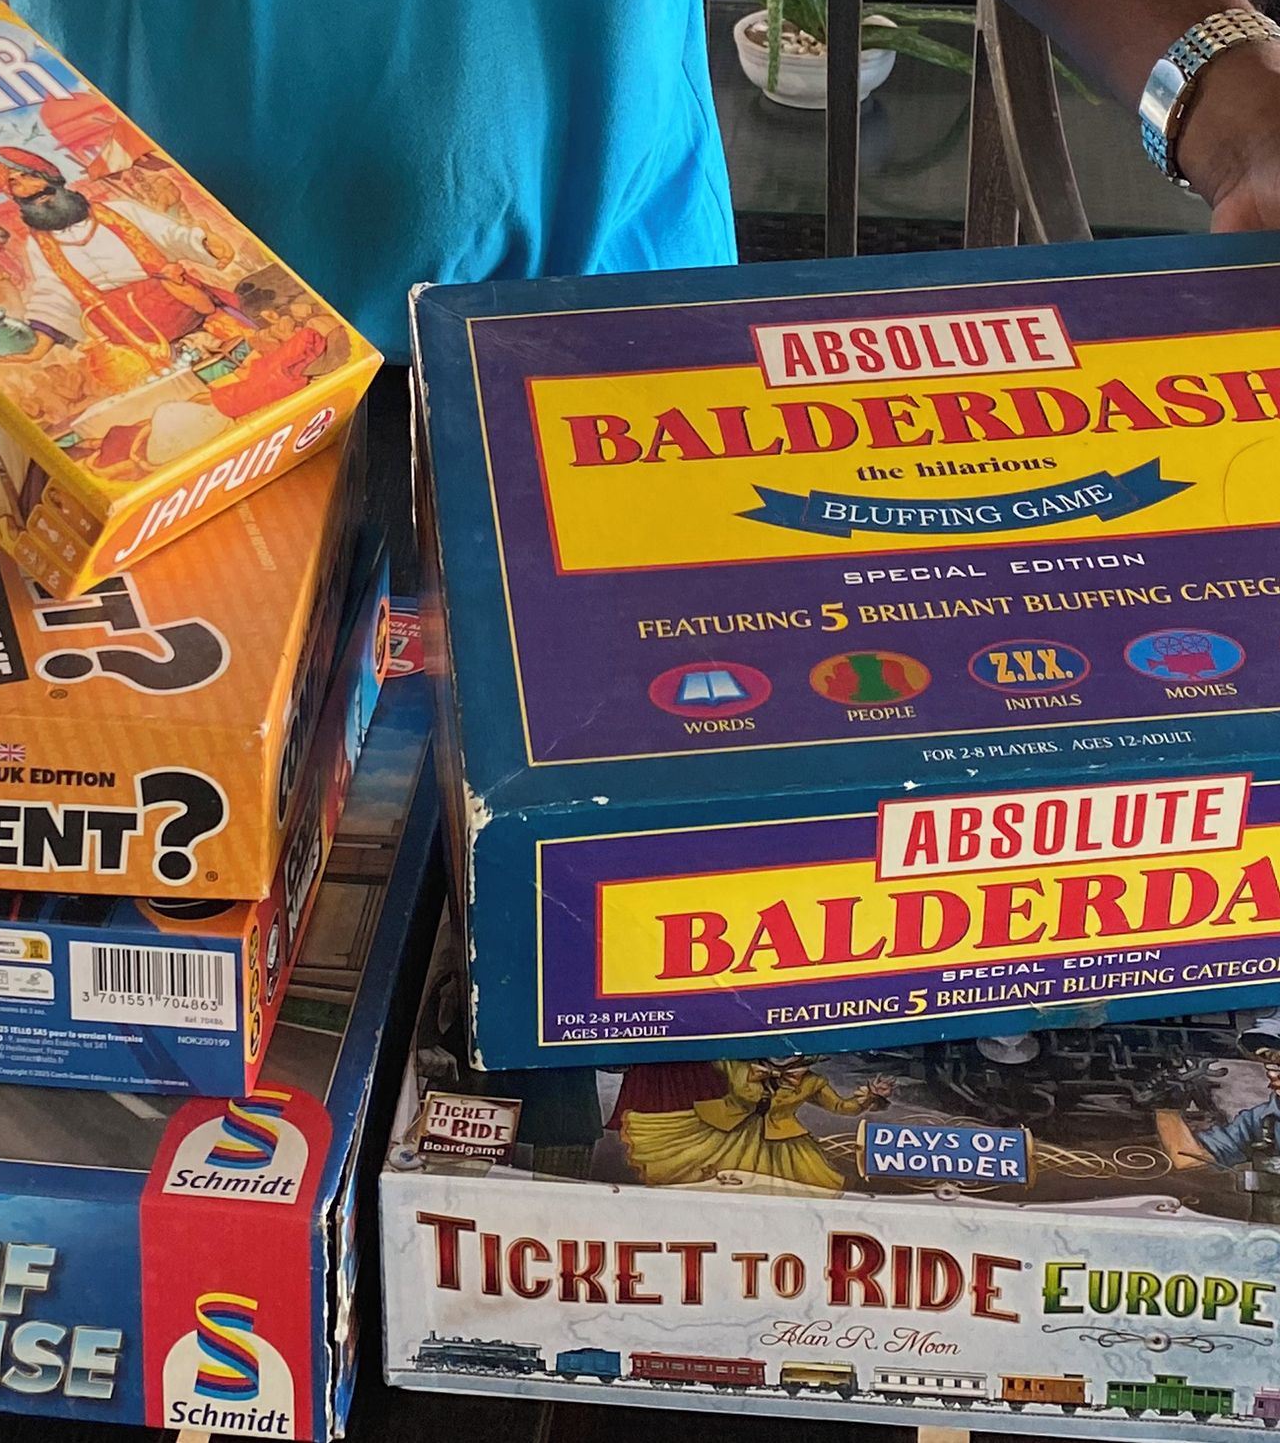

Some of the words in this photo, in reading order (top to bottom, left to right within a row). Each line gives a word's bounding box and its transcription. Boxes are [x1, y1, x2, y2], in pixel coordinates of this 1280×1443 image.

[782, 317, 1054, 379] ABSOLUTE
[855, 461, 904, 482] the
[916, 456, 1057, 478] hilarious
[114, 424, 294, 563] JAIPUR
[821, 498, 1005, 528] BLUFFING
[1010, 483, 1113, 525] GAME
[843, 563, 987, 585] SPECIAL
[1010, 553, 1146, 575] EDITION
[638, 609, 812, 640] FEATURING
[821, 603, 848, 632] 5
[858, 596, 1012, 625] BRILLIANT
[1023, 583, 1172, 614] BLUFFING
[683, 716, 756, 735] WORDS
[846, 704, 917, 723] PEOPLE
[1005, 692, 1083, 711] INITIALS
[1166, 683, 1238, 701] MOVIES
[922, 748, 956, 762] FOR
[959, 746, 985, 759] 2-8
[1072, 736, 1113, 751] AGES
[29, 768, 116, 788] EDITION
[902, 785, 1225, 867] ABSOLUTE
[941, 961, 1045, 982] SPECIAL
[1063, 950, 1161, 971] EDITION
[81, 991, 90, 1003] 3
[99, 993, 154, 1007] 701551
[163, 997, 219, 1012] 704863
[766, 998, 900, 1026] FEATURING
[905, 991, 929, 1015] 5
[935, 981, 1053, 1008] BRILLIANT
[1061, 967, 1177, 994] BLUFFING
[557, 1014, 586, 1026] FOR
[589, 1013, 610, 1024] 2-8
[614, 1010, 676, 1023] PLAYERS
[561, 1028, 598, 1040] AGES
[604, 1025, 669, 1038] 12-ADULT
[432, 1100, 499, 1120] TICKET
[429, 1117, 447, 1128] TO
[451, 1118, 510, 1143] RIDE
[874, 1128, 960, 1151] DAYS
[971, 1133, 1018, 1153] OF
[423, 1141, 505, 1156] Boardgame
[170, 1169, 297, 1198] Schmidt
[416, 1209, 718, 1306] TICKET
[731, 1251, 807, 1300] TO
[825, 1229, 1023, 1325] RIDE
[1042, 1261, 1278, 1329] EUROPE
[760, 1319, 830, 1348] Alan
[836, 1327, 879, 1352] R.
[882, 1326, 961, 1356] Moon
[169, 1401, 290, 1435] Schmidt
